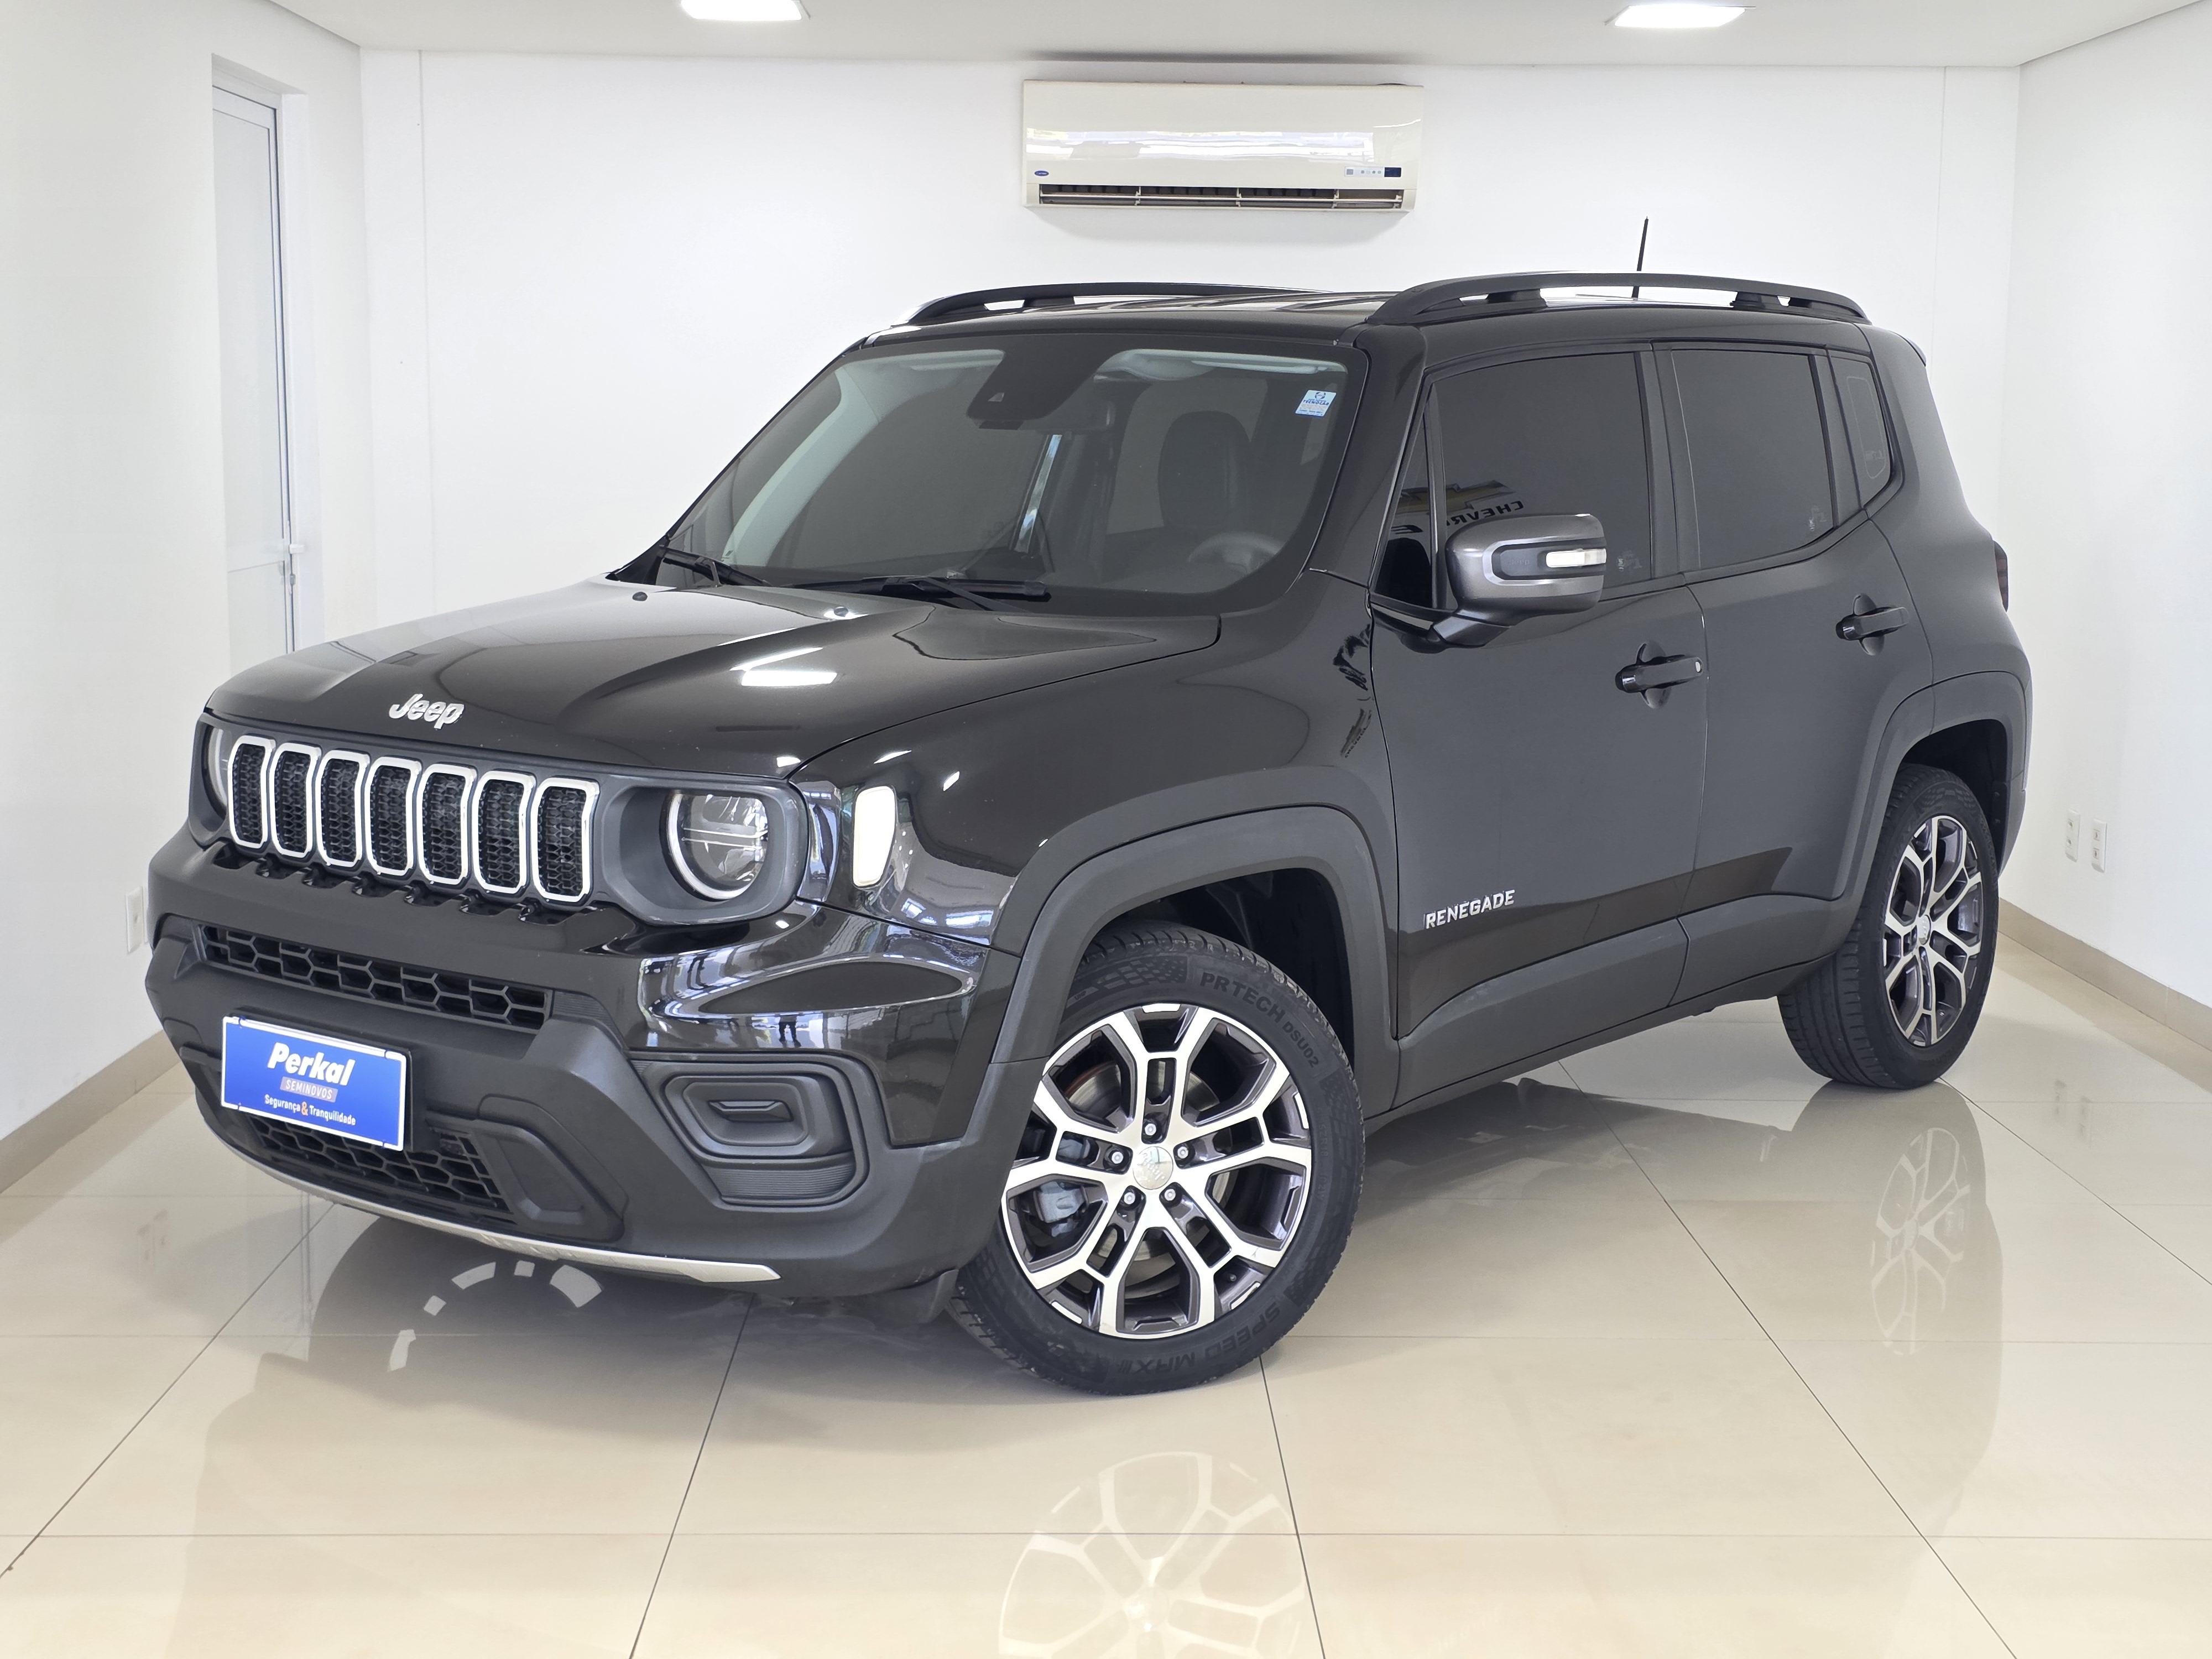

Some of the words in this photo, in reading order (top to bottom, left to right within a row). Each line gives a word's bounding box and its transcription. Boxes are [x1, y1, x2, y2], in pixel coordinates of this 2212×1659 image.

[389, 693, 465, 729] Jeep
[1424, 889, 1515, 930] RENEGADE
[1199, 972, 1286, 1023] PRTECH
[267, 1042, 356, 1086] Perkal
[264, 1093, 301, 1114] Segurança
[301, 1100, 309, 1117] &
[309, 1104, 357, 1126] Tranquilidade
[285, 1079, 333, 1100] SEMINOVOS
[1204, 1301, 1282, 1359] SPEED
